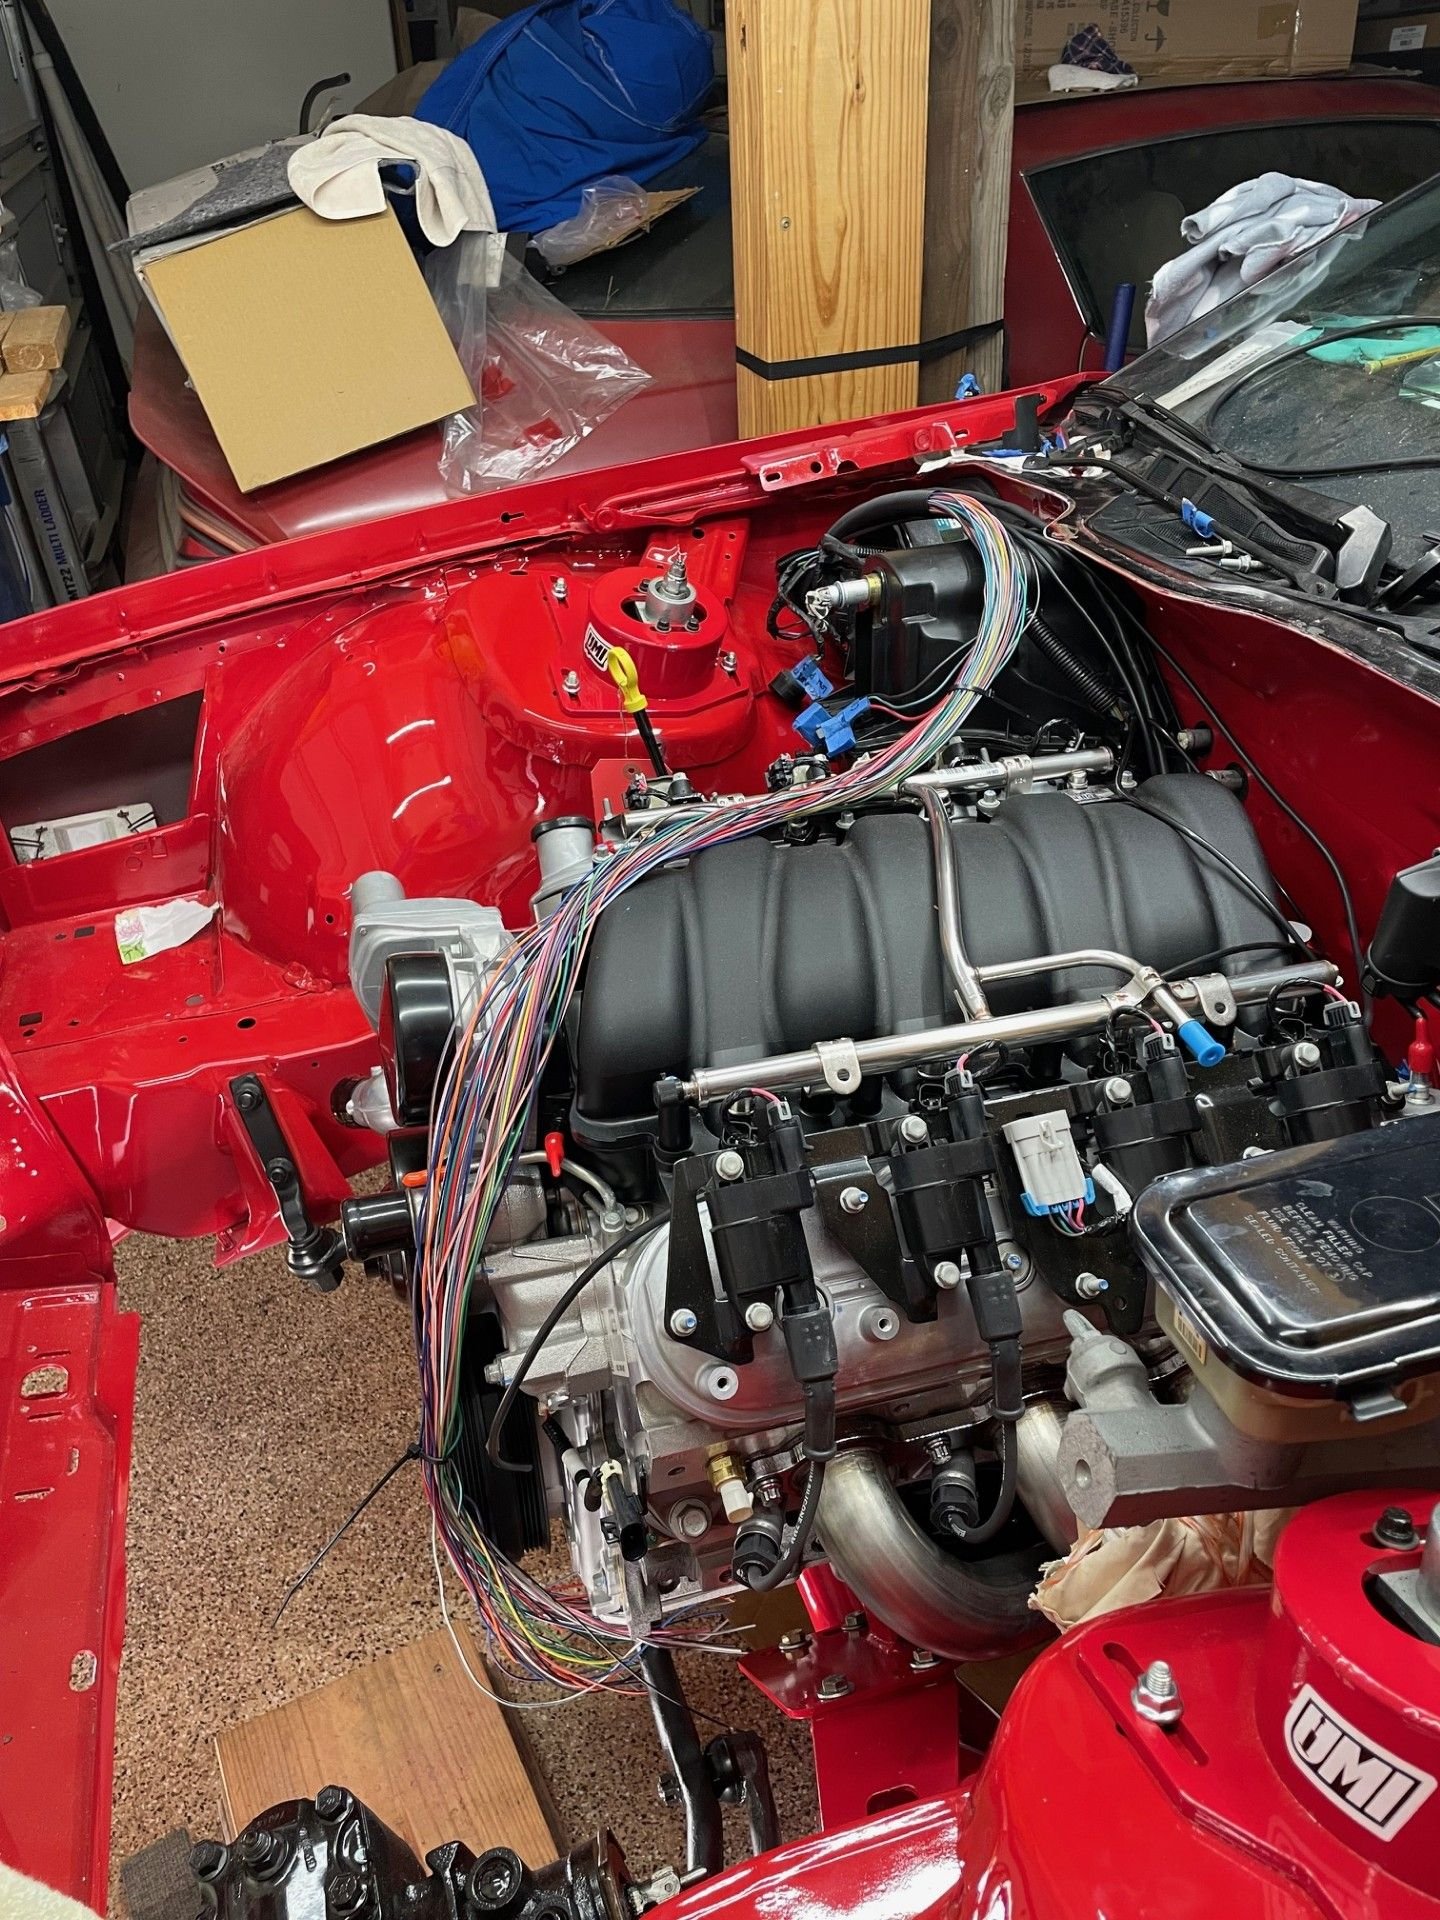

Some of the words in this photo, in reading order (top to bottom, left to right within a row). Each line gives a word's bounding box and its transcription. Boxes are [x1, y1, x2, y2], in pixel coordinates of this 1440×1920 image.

[34, 488, 57, 532] LADDER
[49, 533, 68, 566] MULTI
[1243, 1214, 1276, 1246] SEALED
[1270, 1207, 1291, 1224] USE
[1282, 1204, 1318, 1236] BEFORE
[1256, 1210, 1282, 1234] FLUID
[1281, 1236, 1308, 1260] FROM
[1295, 1202, 1325, 1228] CLEAN
[1322, 1230, 1354, 1258] FILLER
[1353, 1261, 1374, 1278] CAP
[1292, 1699, 1421, 1826] UMI
